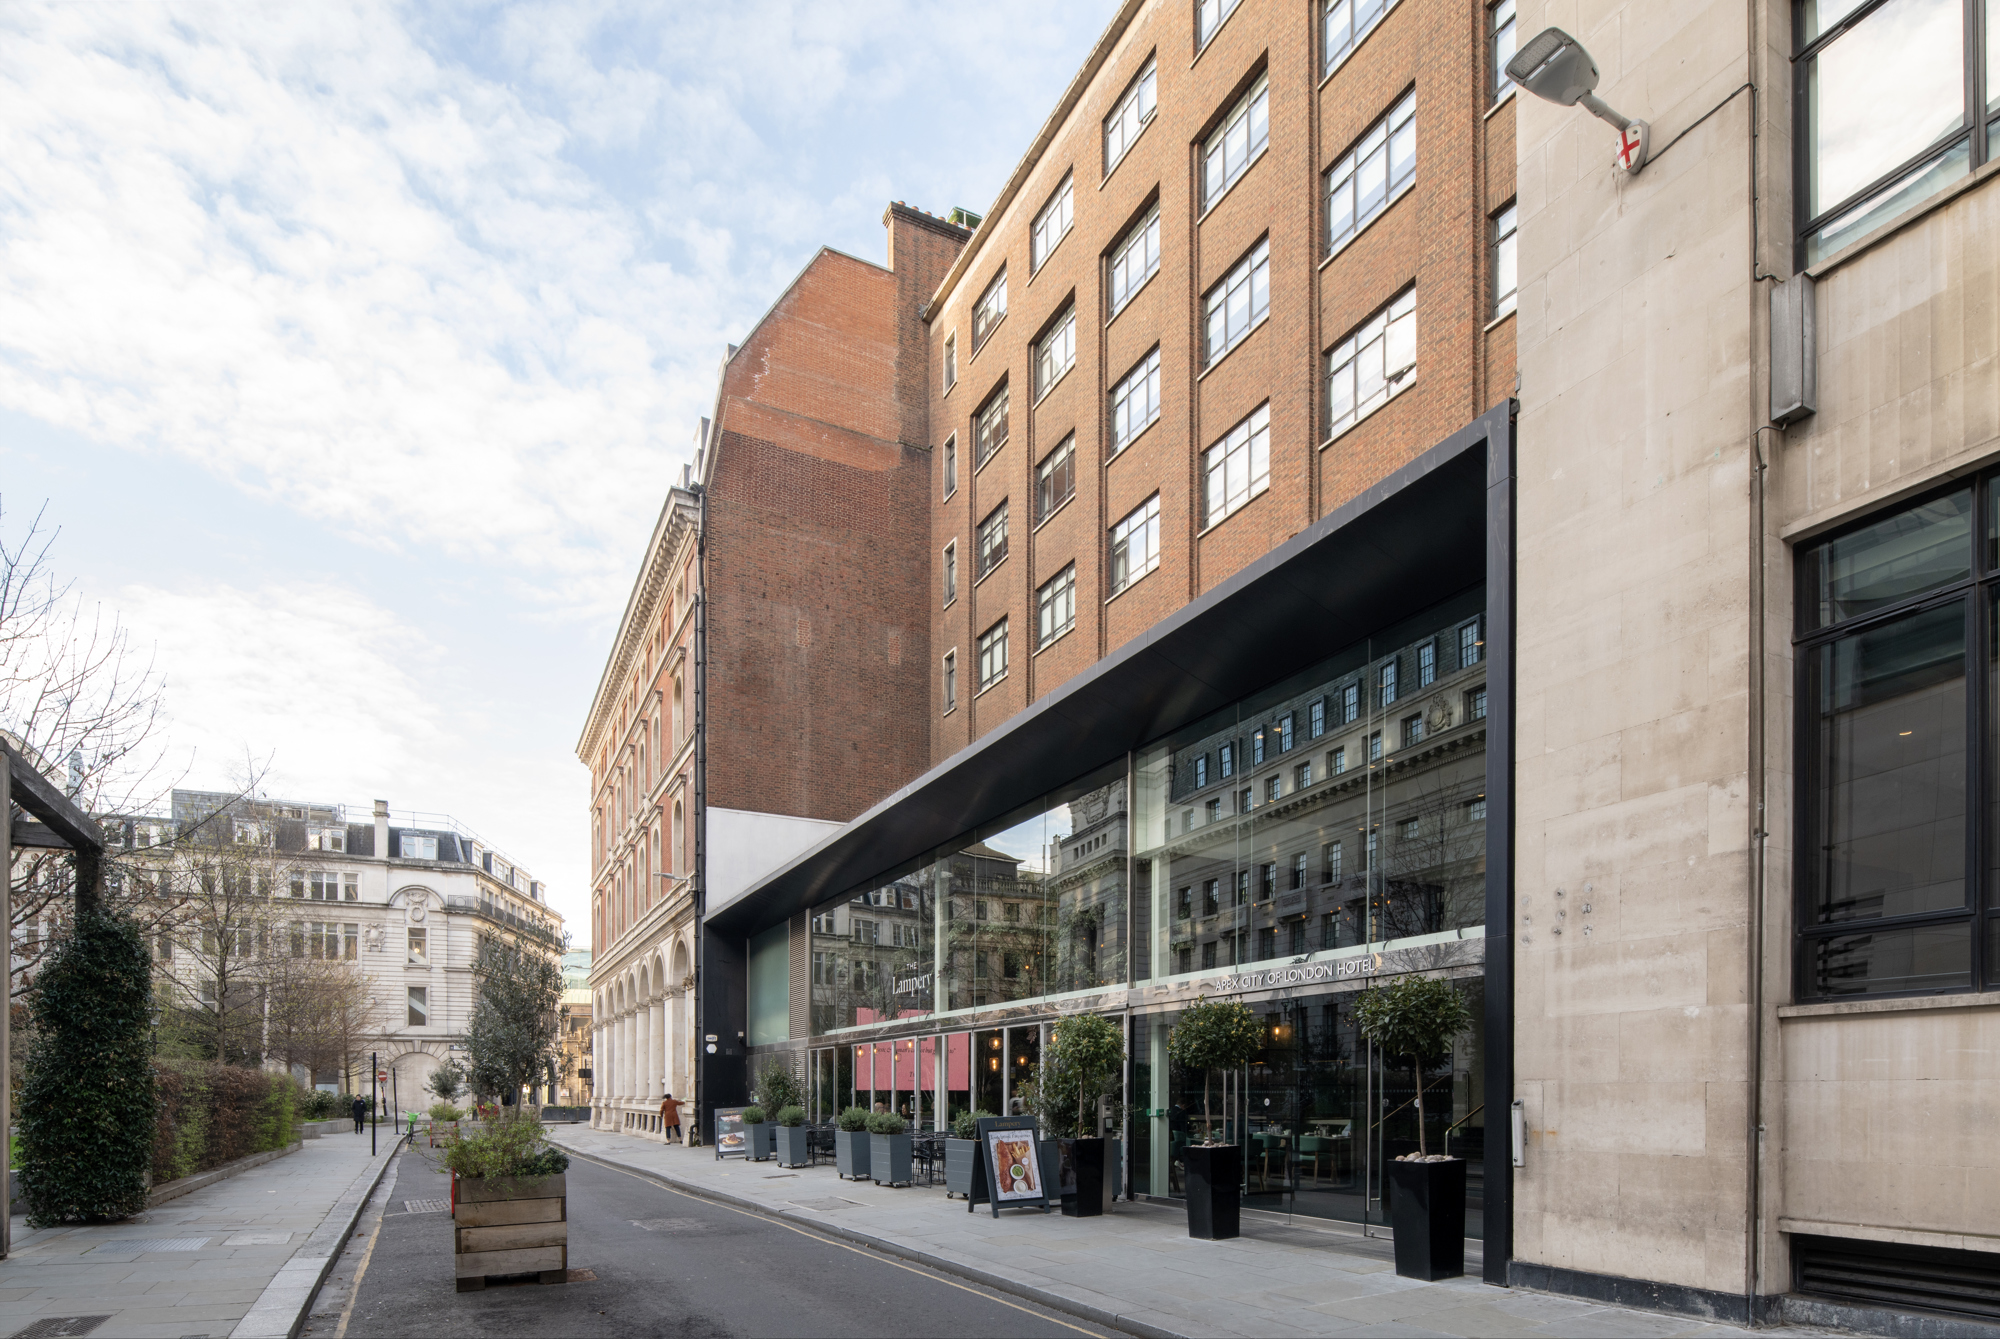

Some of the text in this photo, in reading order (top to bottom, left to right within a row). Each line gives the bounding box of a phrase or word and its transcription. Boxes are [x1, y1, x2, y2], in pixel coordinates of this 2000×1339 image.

[906, 961, 918, 971] THE
[1215, 958, 1376, 992] APEX CITY OF LONDON HOTEL
[892, 973, 933, 998] Lampery
